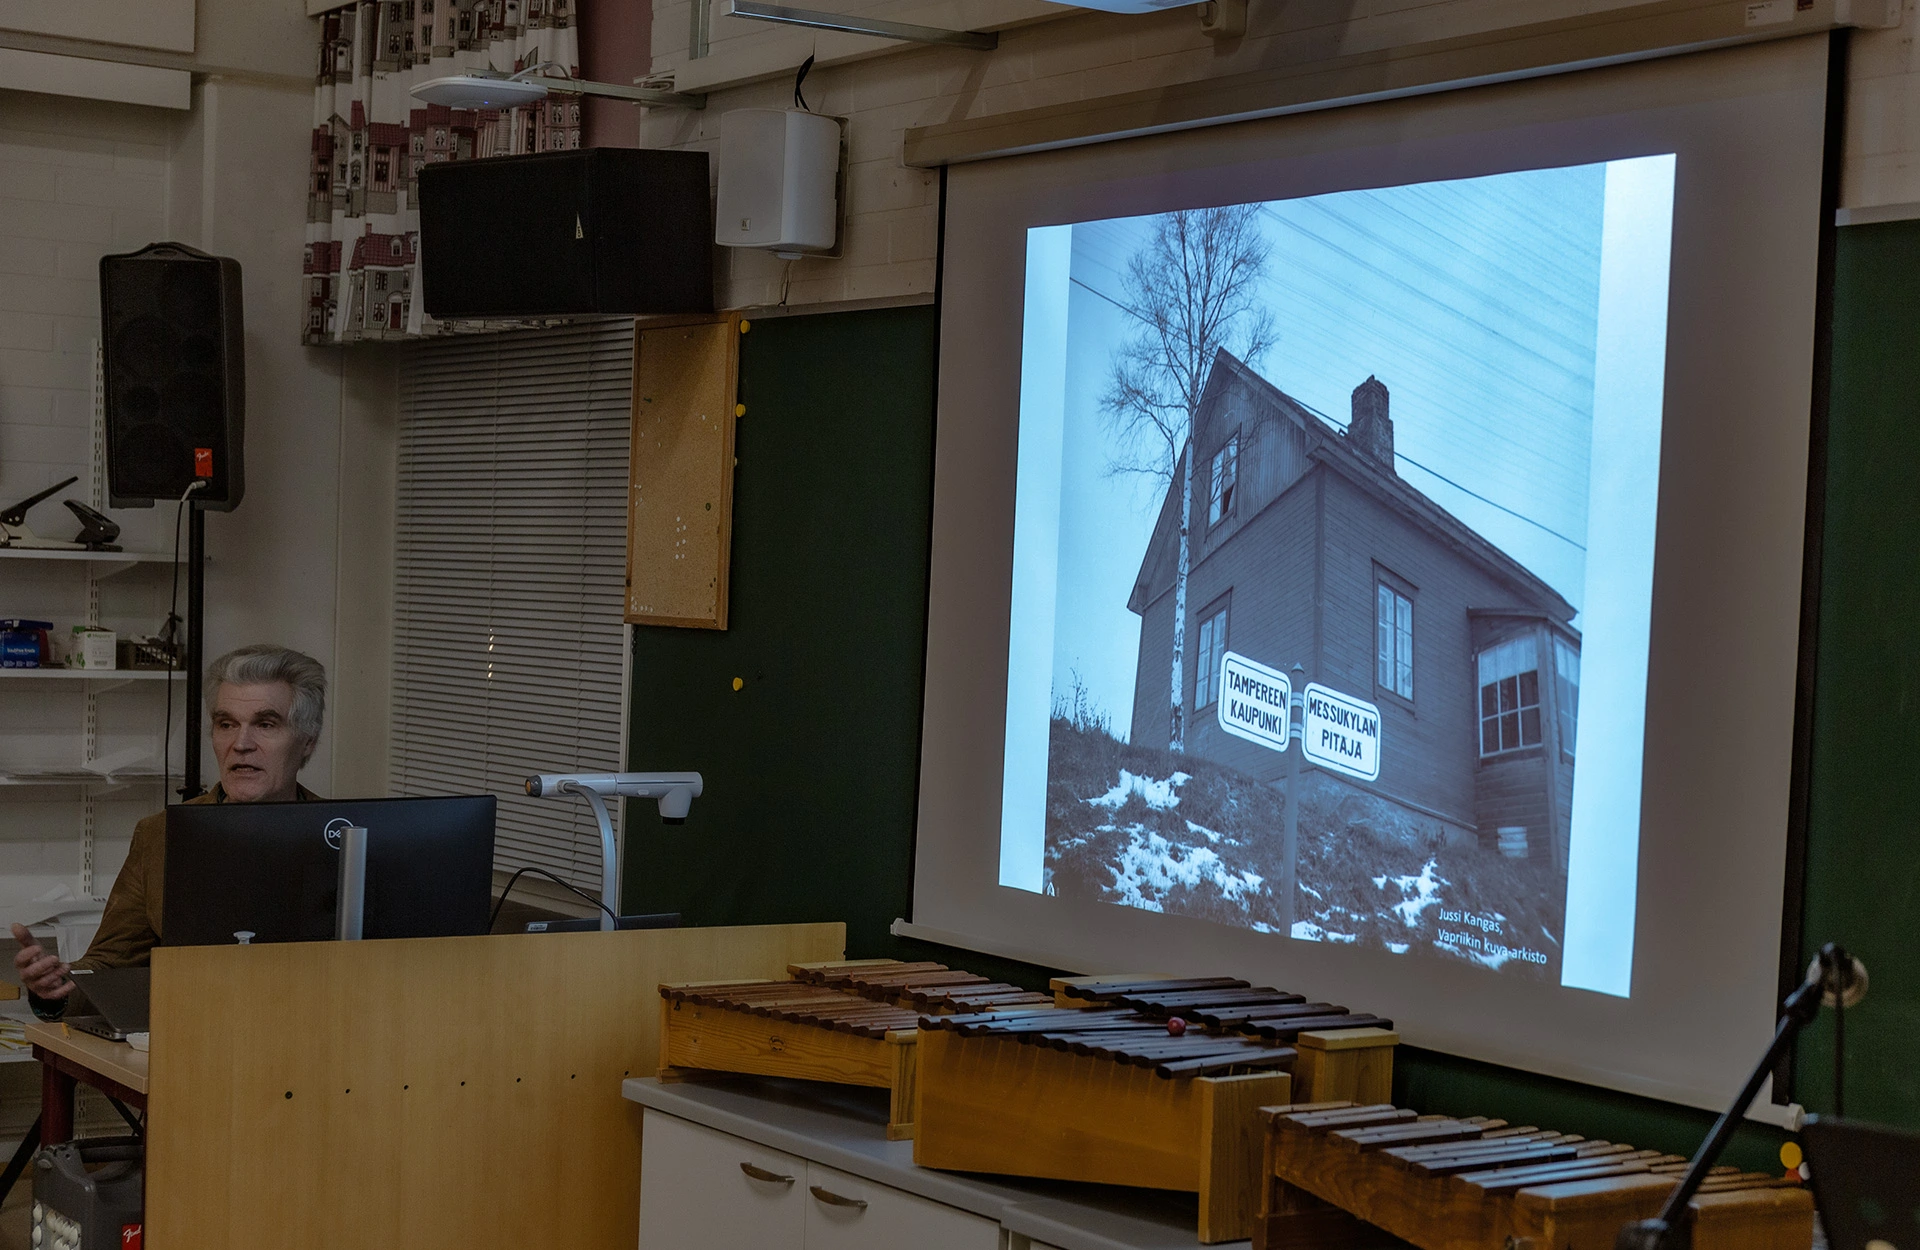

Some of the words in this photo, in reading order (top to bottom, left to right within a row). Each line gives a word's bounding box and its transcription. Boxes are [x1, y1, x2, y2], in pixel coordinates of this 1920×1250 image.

[1228, 670, 1287, 710] TAMPEREEN
[1230, 698, 1282, 736] KAUPUNKI
[1308, 697, 1377, 739] MESSUKYLÄN
[1321, 729, 1363, 760] PITÄJÄ
[328, 829, 341, 839] DE
[1438, 908, 1462, 922] Jussi
[1463, 911, 1504, 936] Kangas,
[1438, 928, 1481, 950] Vapriikin
[1484, 937, 1548, 965] kuva-arkisto
